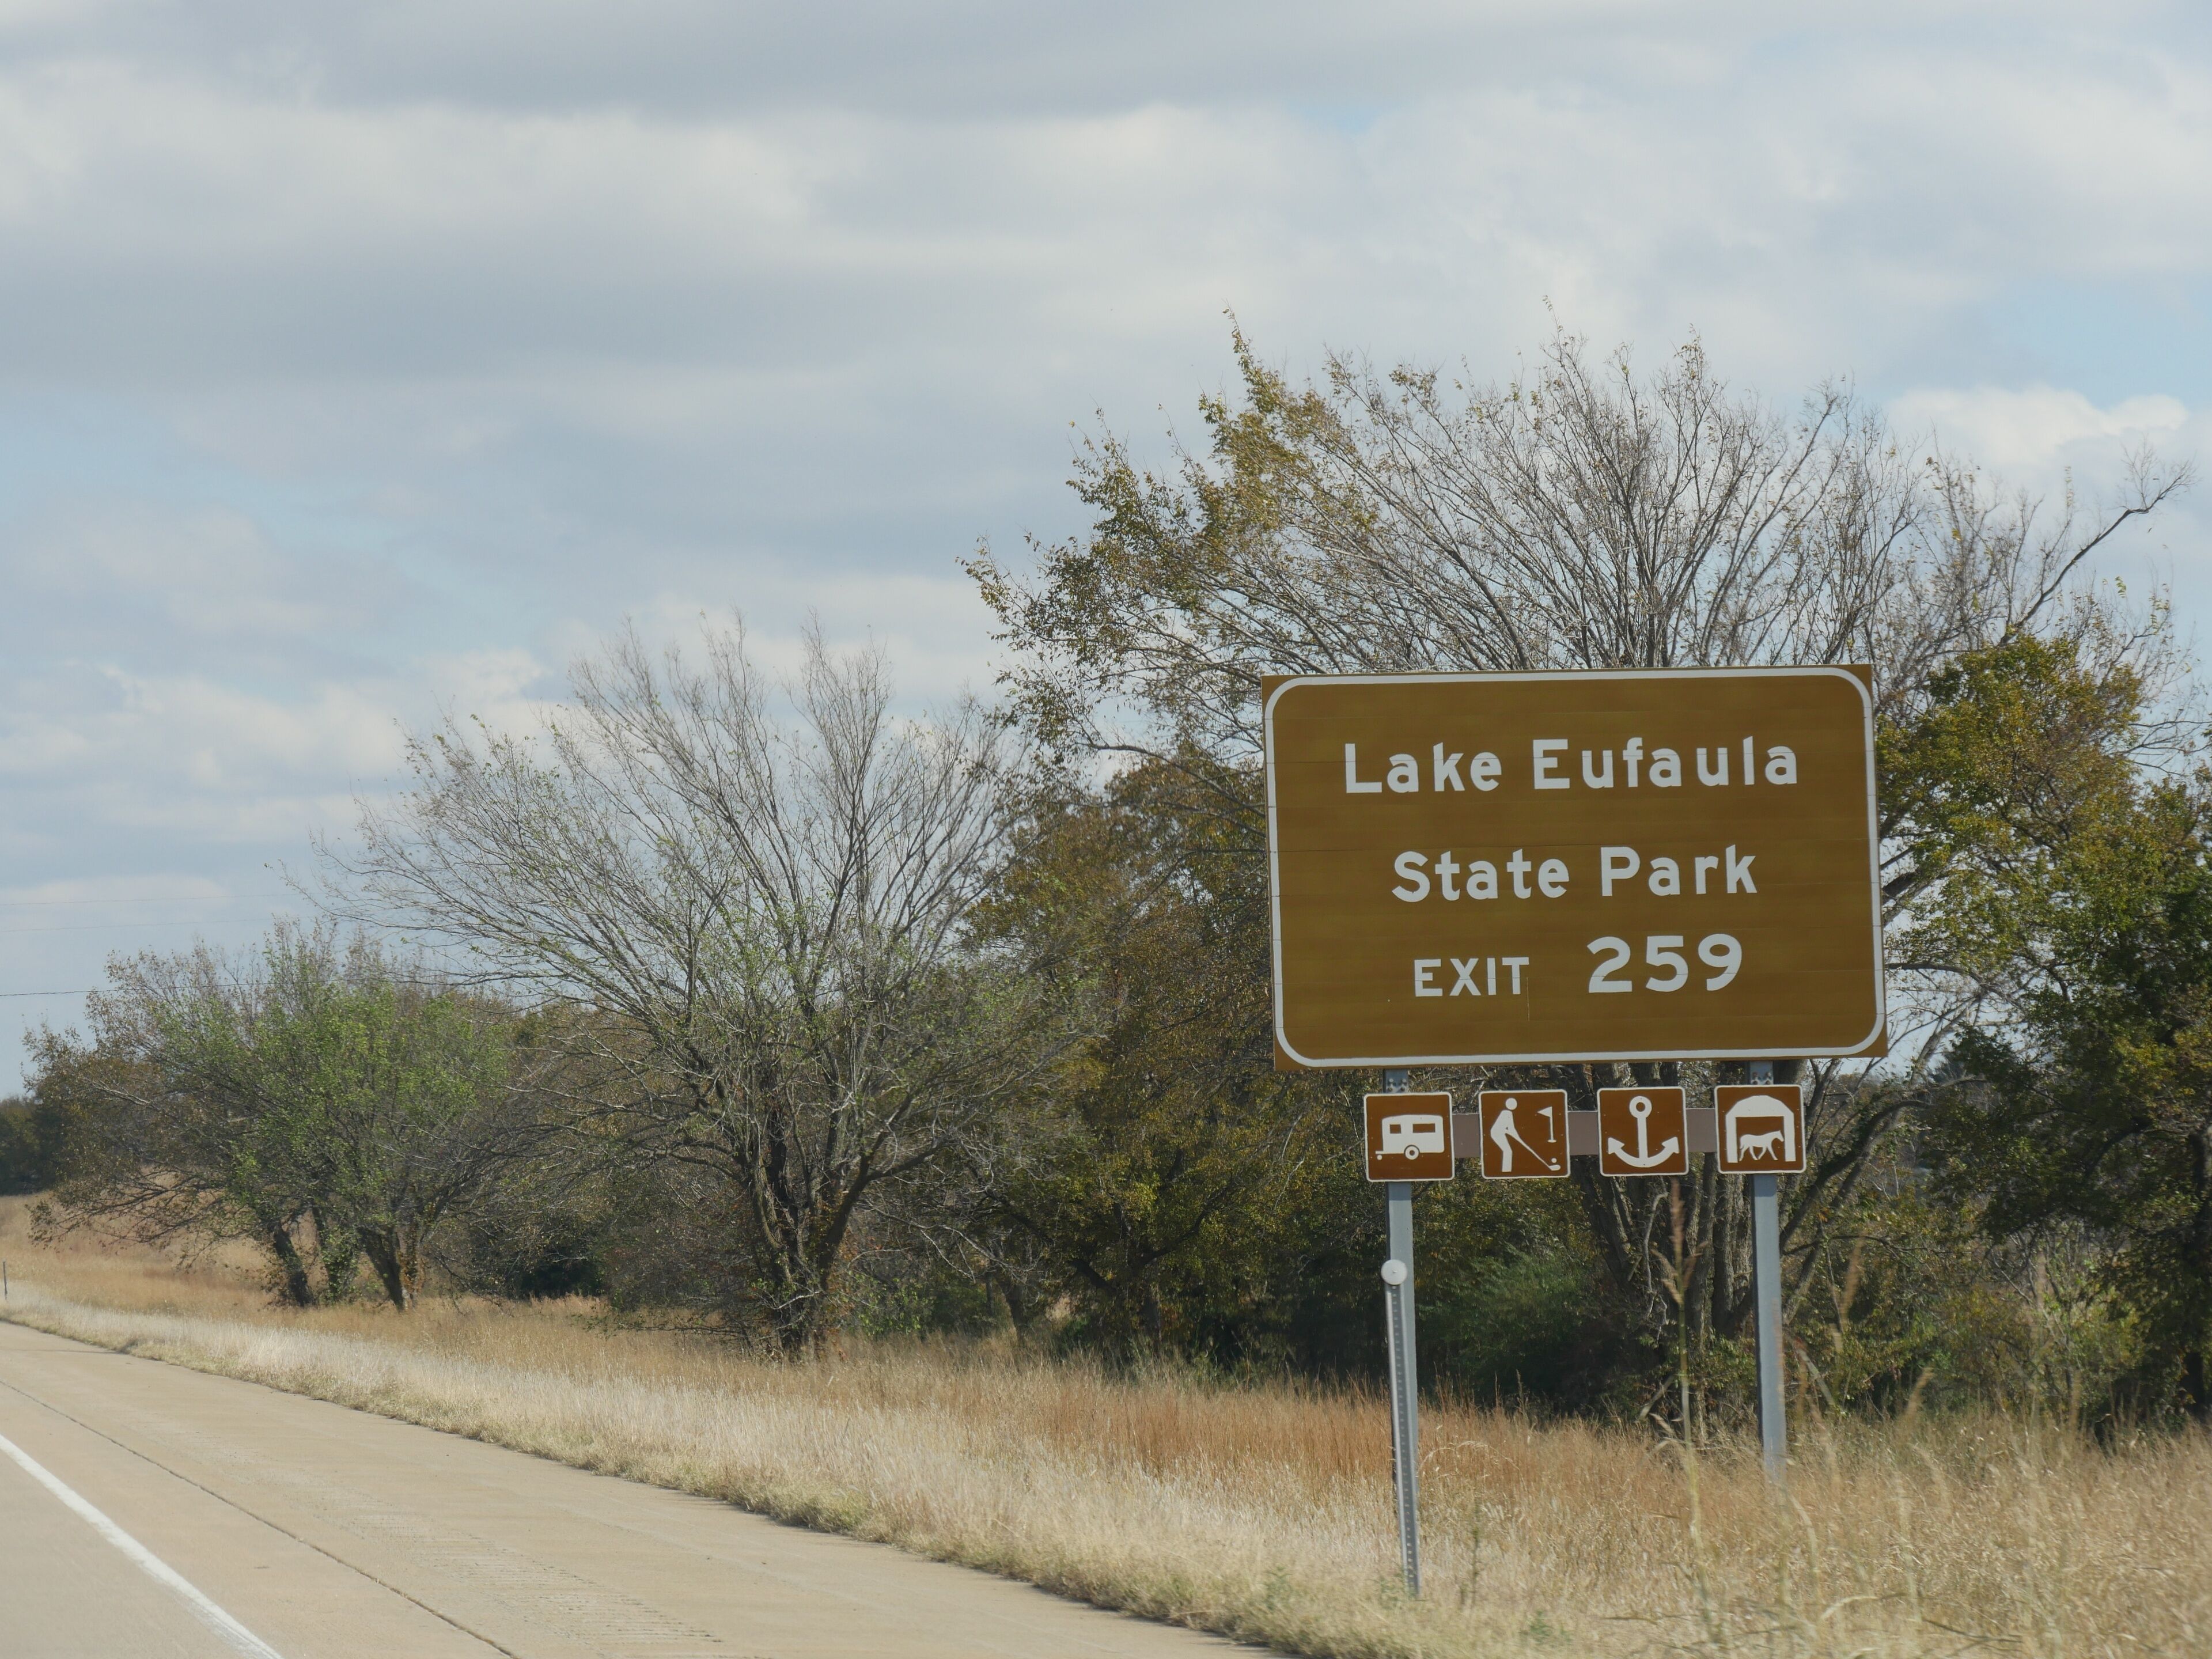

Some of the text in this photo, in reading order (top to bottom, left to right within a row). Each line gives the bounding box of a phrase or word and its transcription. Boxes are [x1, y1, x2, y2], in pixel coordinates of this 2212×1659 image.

[1345, 736, 1796, 793] Lake Eufaula
[1392, 845, 1757, 902] State Park
[1415, 934, 1741, 997] EXIT 259
